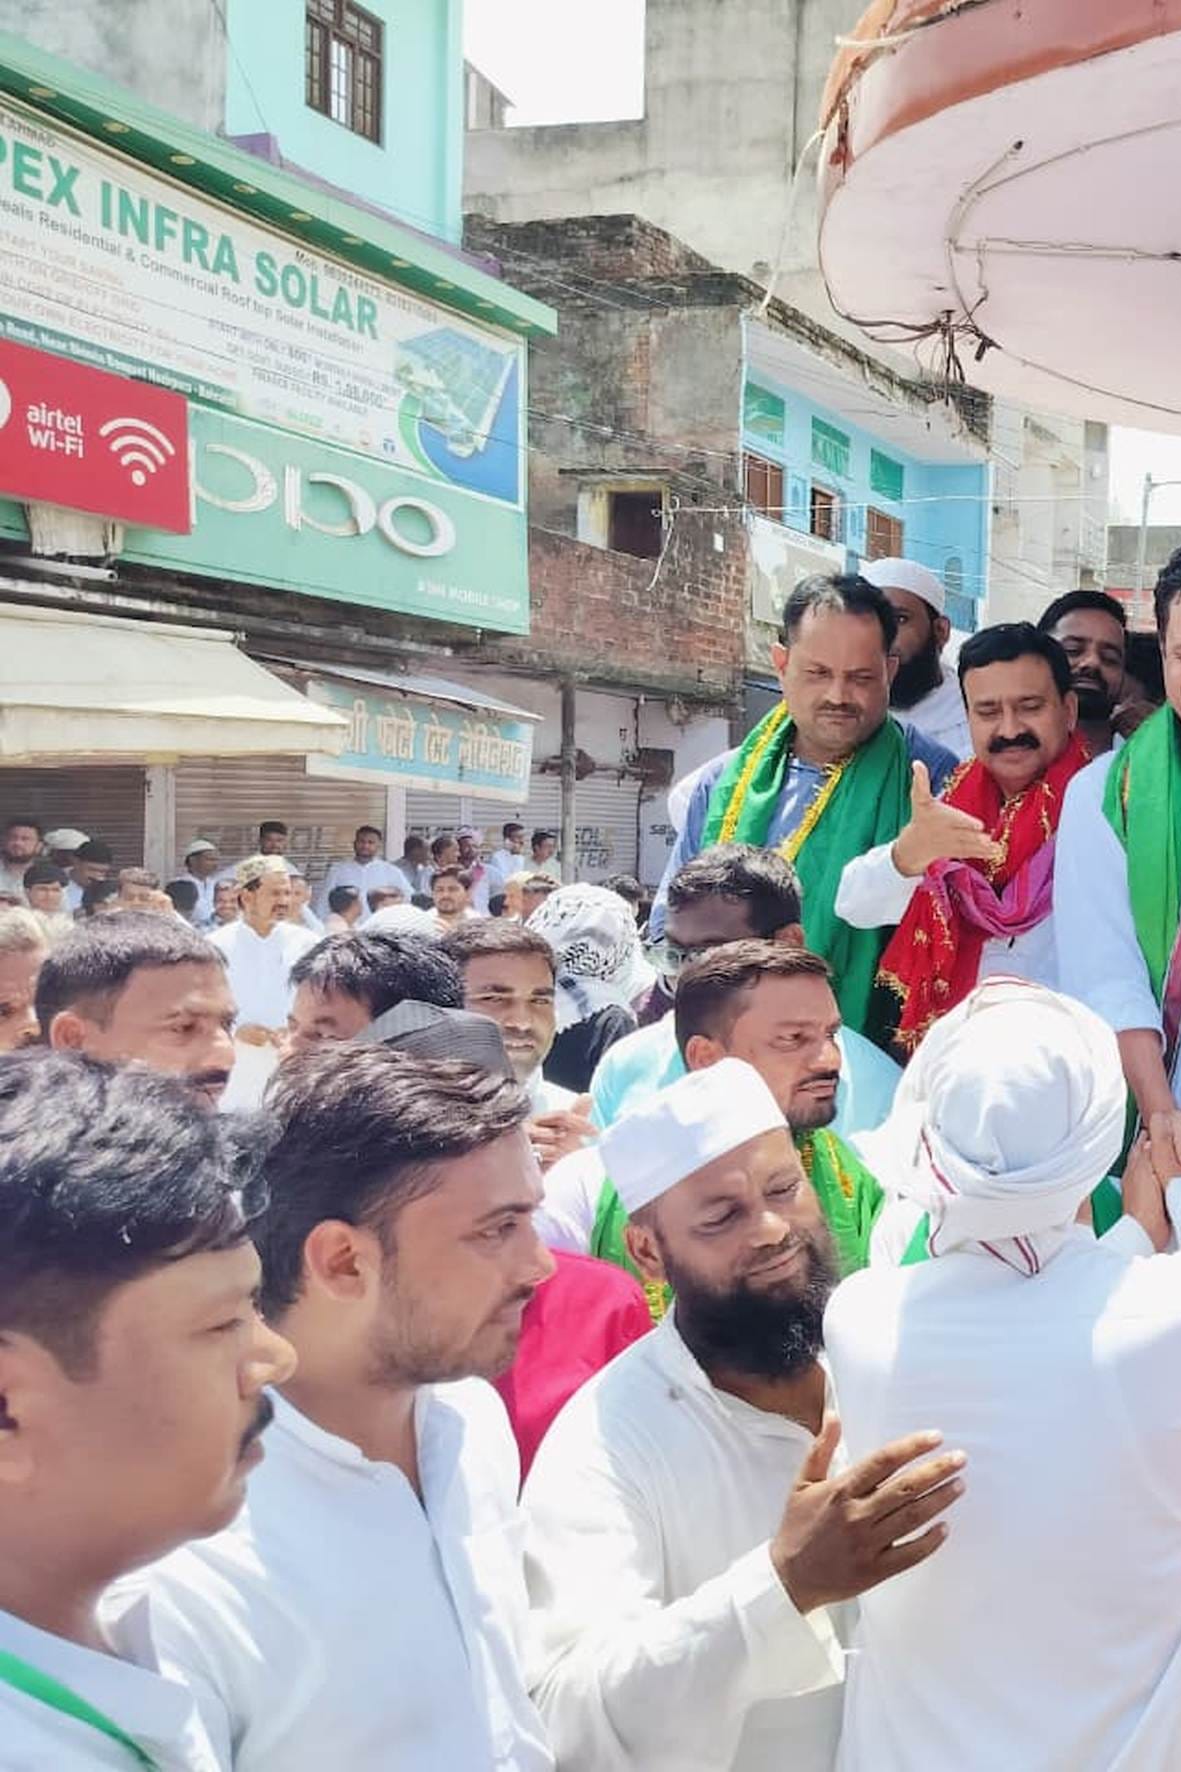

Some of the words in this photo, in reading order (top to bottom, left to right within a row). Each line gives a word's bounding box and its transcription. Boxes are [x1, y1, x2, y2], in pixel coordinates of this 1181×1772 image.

[0, 136, 81, 217] EX
[101, 180, 240, 283] INFRA
[255, 251, 378, 341] SOLAR
[39, 211, 121, 257] Residential
[125, 246, 137, 263] &
[140, 253, 218, 296] Commercial
[27, 402, 83, 436] airtel
[27, 425, 84, 459] Wi-Fi
